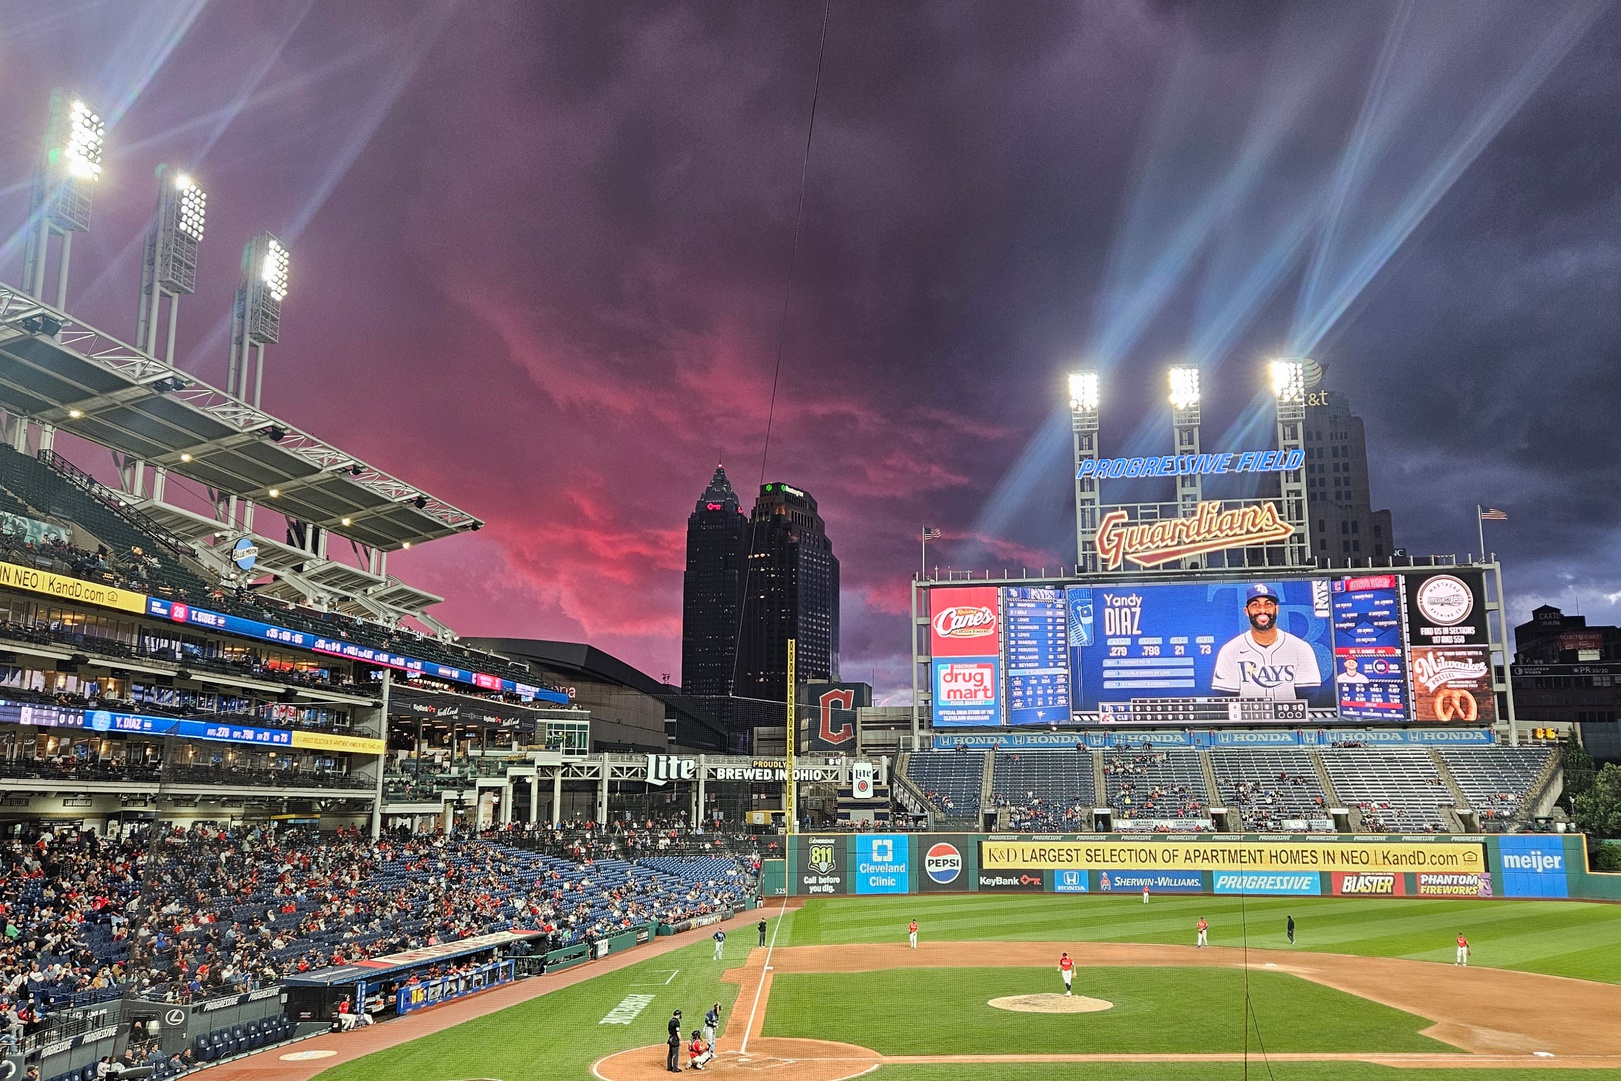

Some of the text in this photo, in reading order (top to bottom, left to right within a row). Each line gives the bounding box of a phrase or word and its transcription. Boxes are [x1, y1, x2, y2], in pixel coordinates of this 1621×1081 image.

[1076, 449, 1305, 479] PROGRESSIVE FIELD
[1095, 501, 1295, 570] Guardians
[0, 565, 104, 602] IN NEO KandD.com
[1104, 593, 1142, 607] Yandy
[173, 606, 184, 618] 28
[1105, 607, 1142, 635] DIAZ
[1449, 626, 1476, 635] SECTIONS
[1109, 646, 1127, 656] .279
[1174, 645, 1185, 655] 21
[1200, 645, 1211, 655] 73
[1415, 651, 1487, 684] Milwaukee
[943, 663, 984, 687] drug
[1238, 661, 1295, 688] RAYS
[1432, 673, 1455, 685] PRETZEL
[947, 685, 995, 699] mart
[953, 737, 1009, 745] HONDA
[1026, 735, 1082, 744] HONDA
[1127, 734, 1186, 742] HONDA
[1233, 733, 1293, 742] HONDA
[1340, 732, 1404, 741] HONDA
[1422, 731, 1488, 740] HONDA
[645, 754, 696, 786] Lite
[753, 760, 787, 768] PROUDLY
[717, 768, 822, 781] BREWED IN OHIO
[811, 847, 832, 863] 811
[988, 847, 1458, 866] K&D LARGEST SELECTION OF APARTMENT HOMES IN NEO KandD.com
[928, 859, 960, 867] PEPSI
[1504, 851, 1562, 872] meijer
[860, 863, 906, 873] Cleveland
[803, 875, 840, 884] Call before
[869, 876, 896, 886] Clinic
[980, 876, 1019, 886] KeyBank
[1216, 875, 1312, 890] PROGRESSIVE
[1420, 875, 1478, 885] PHANTOM
[775, 887, 786, 895] 325
[809, 885, 822, 893] you
[1420, 885, 1478, 895] FIREWORKS
[248, 987, 281, 1001] PROGRESSIVE
[204, 997, 238, 1011] PROGRESSIVE
[82, 1025, 118, 1045] PROGRESSIVE
[40, 1039, 73, 1059] PROGRESSIVE
